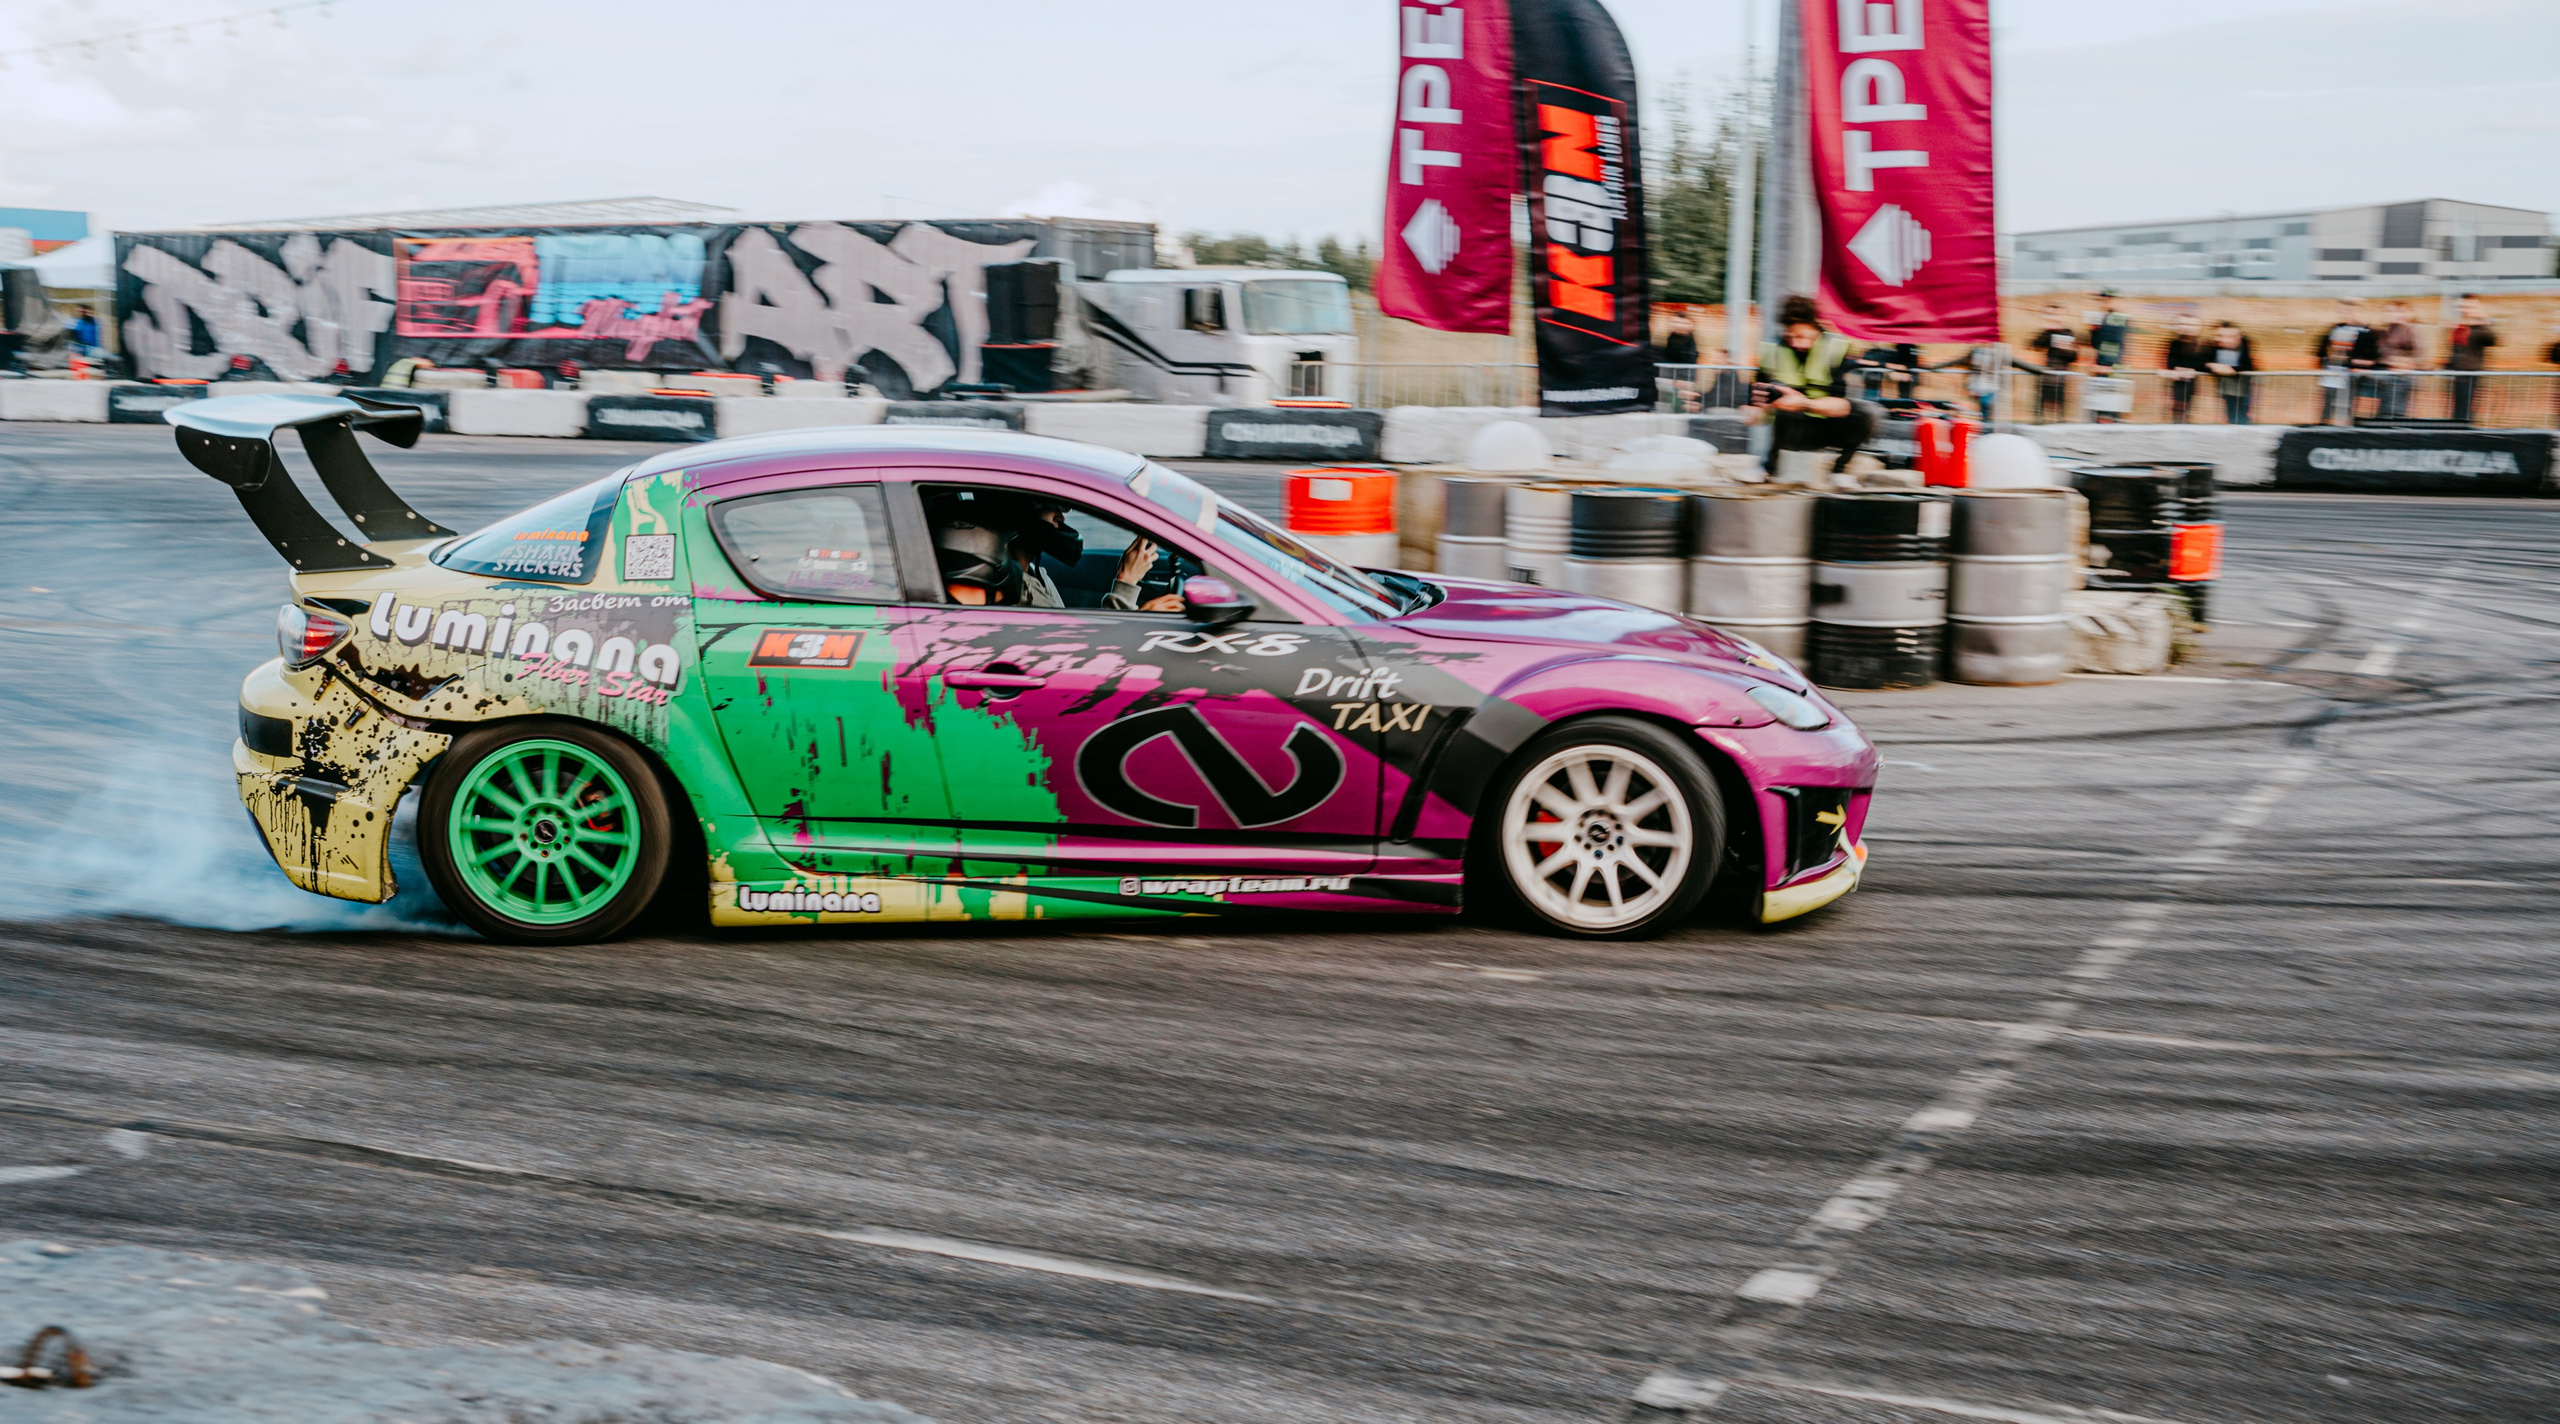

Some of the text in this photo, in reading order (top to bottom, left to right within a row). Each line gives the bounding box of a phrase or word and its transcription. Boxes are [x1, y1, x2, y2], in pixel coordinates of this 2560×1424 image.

[719, 221, 1038, 393] ART
[502, 544, 585, 563] #SHARK
[493, 558, 584, 578] STICKERS
[549, 593, 690, 613] Засвет от
[757, 633, 857, 659] K3N
[1138, 631, 1310, 656] RX-8
[516, 652, 668, 706] Fiber Star
[1294, 666, 1403, 699] Drift
[1331, 702, 1433, 733] TAXI
